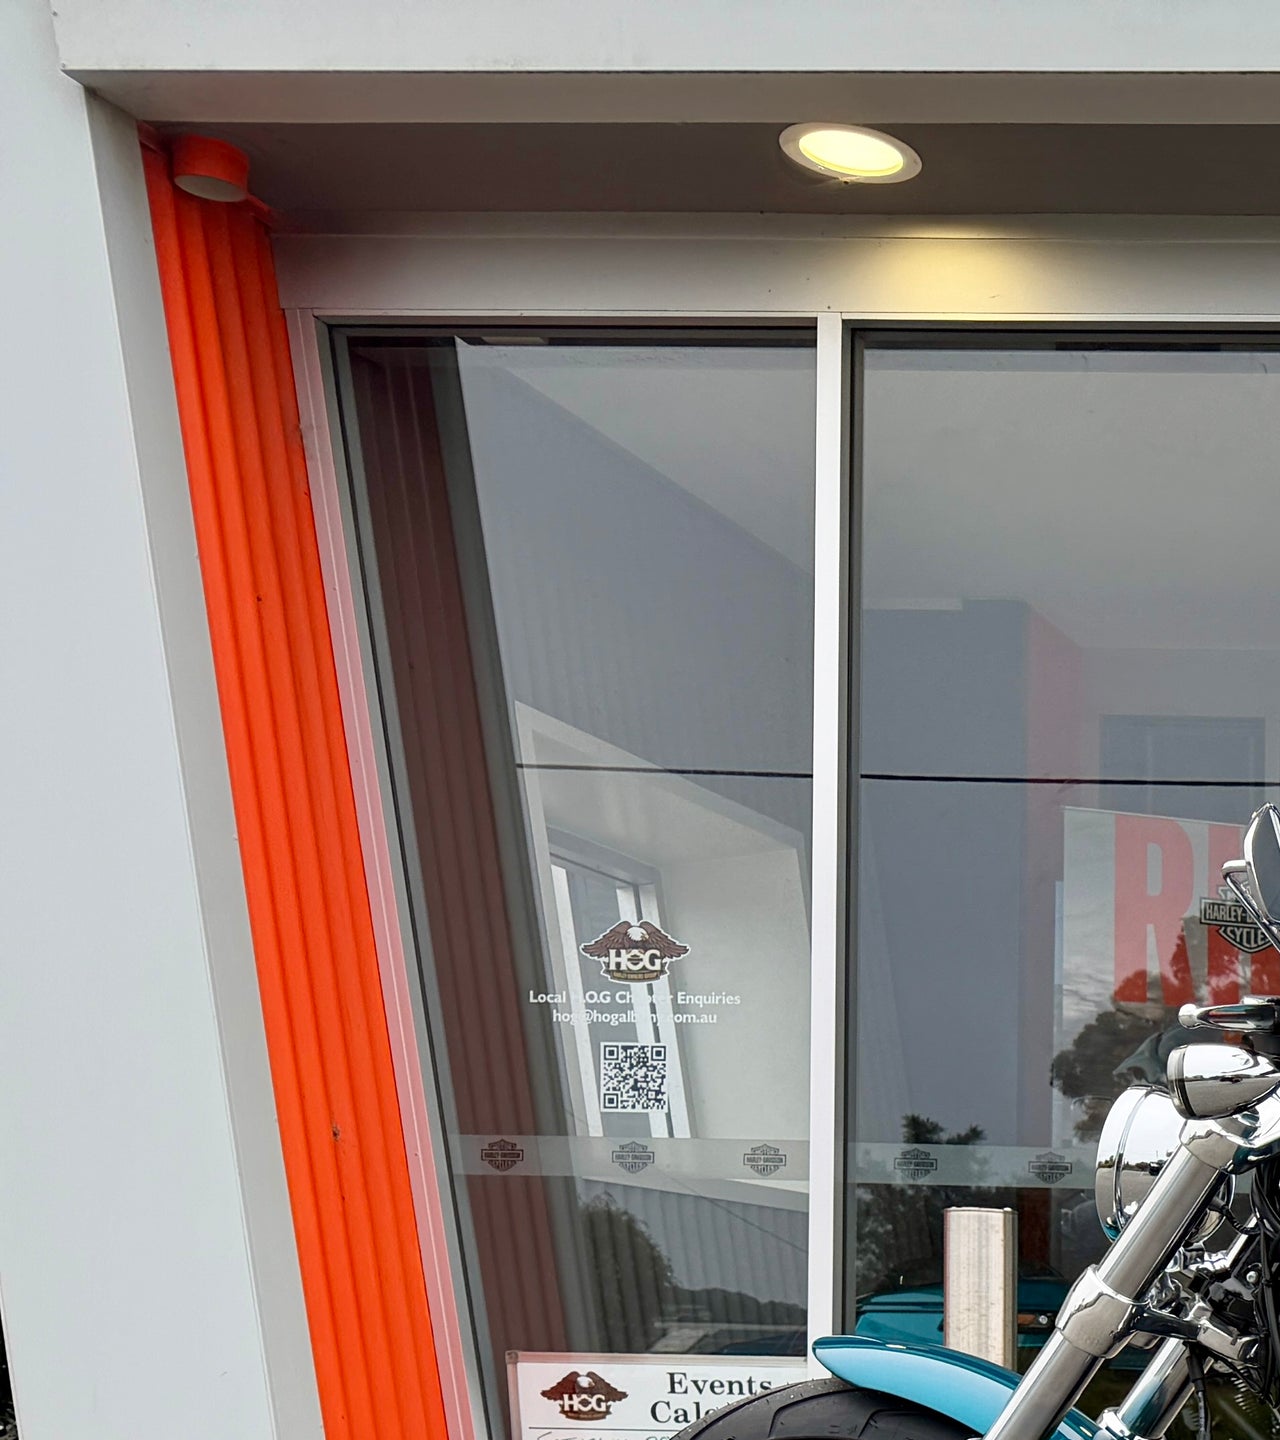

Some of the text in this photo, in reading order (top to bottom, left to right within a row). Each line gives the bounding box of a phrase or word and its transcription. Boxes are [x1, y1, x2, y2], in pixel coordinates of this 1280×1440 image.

[608, 949, 661, 971] HOG
[529, 990, 566, 1003] Local
[570, 991, 611, 1004] .O.G
[677, 991, 741, 1008] Enquiries
[667, 1372, 772, 1396] Events
[563, 1393, 607, 1412] HOG
